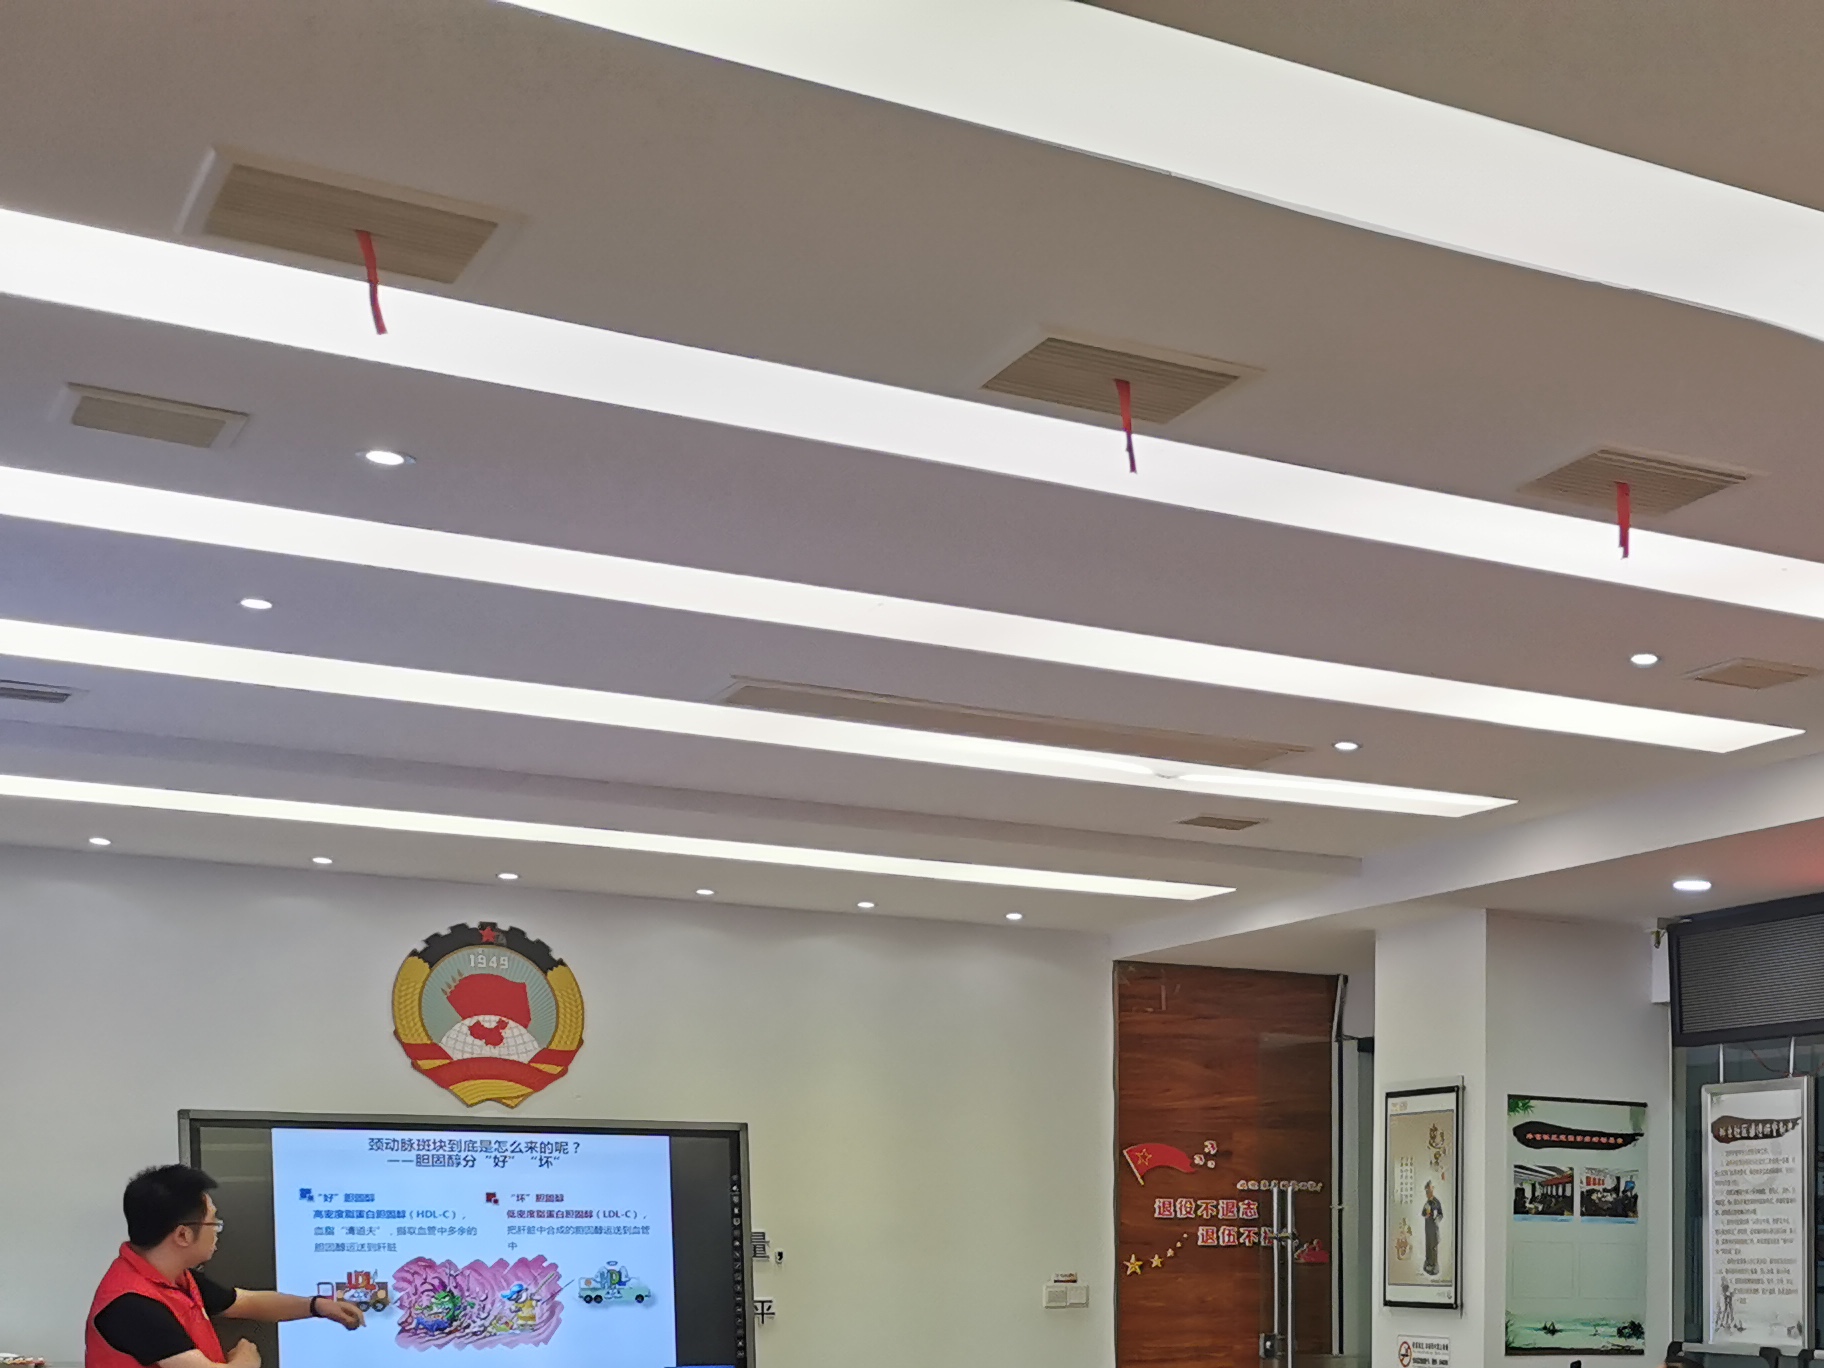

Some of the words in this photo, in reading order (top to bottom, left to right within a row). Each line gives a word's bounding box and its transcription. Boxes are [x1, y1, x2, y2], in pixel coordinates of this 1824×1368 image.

[470, 954, 509, 968] 1949
[1154, 1198, 1259, 1220] 退役不退志
[1197, 1226, 1299, 1247] 退伍不
